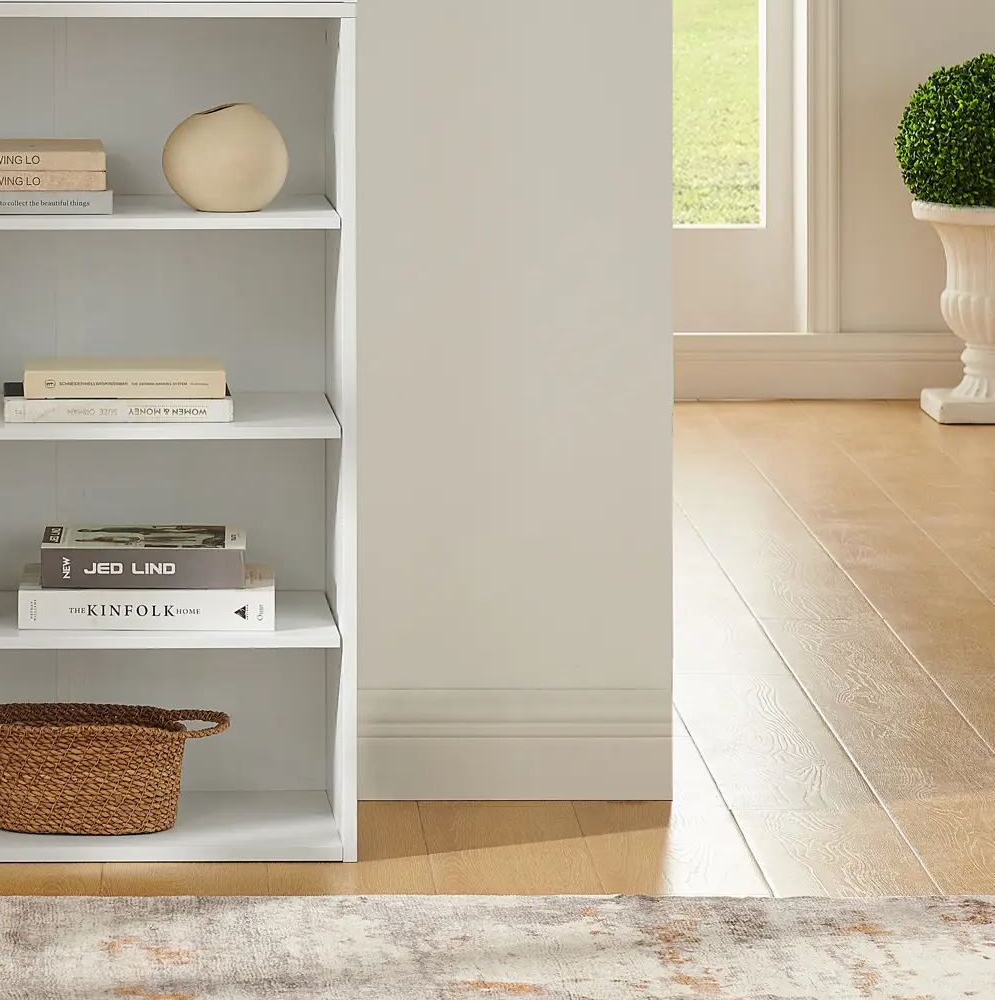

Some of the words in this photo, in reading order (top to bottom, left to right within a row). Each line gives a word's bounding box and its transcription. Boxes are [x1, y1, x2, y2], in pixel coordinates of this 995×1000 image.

[25, 155, 40, 165] LO
[26, 176, 41, 186] LO
[70, 199, 90, 208] things
[128, 408, 161, 416] MONEY
[163, 408, 170, 416] &
[172, 408, 207, 416] WOMEN
[62, 556, 71, 579] NEW
[84, 562, 123, 575] JED
[131, 562, 176, 575] LIND
[87, 604, 175, 617] KINFOLK
